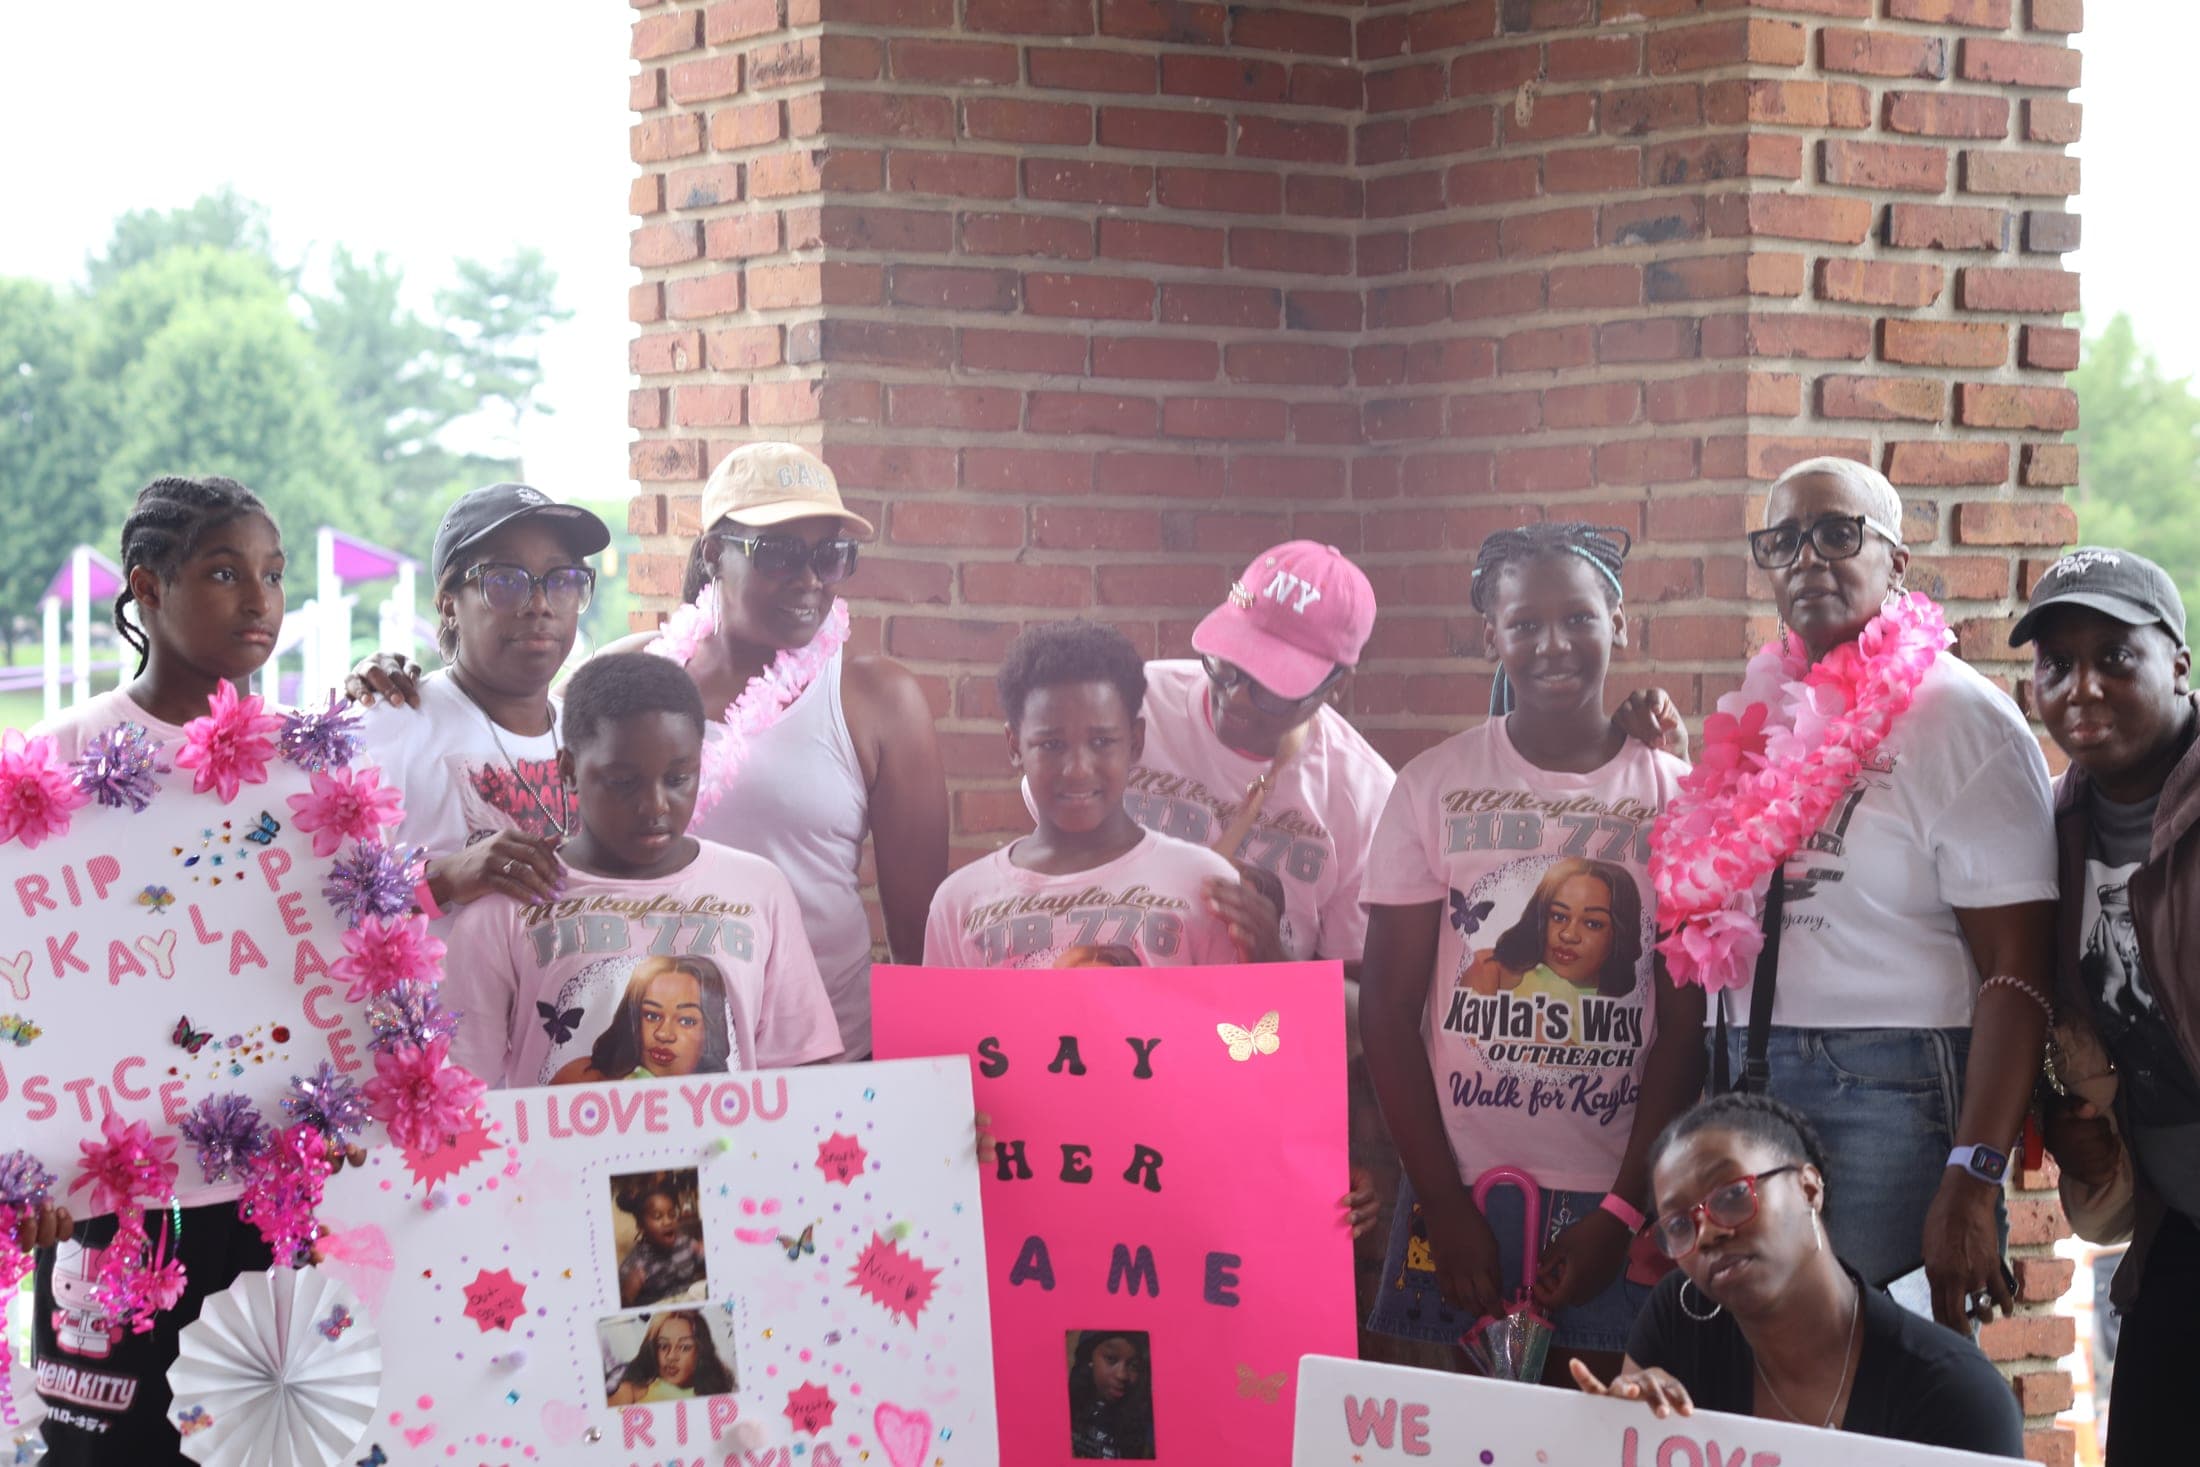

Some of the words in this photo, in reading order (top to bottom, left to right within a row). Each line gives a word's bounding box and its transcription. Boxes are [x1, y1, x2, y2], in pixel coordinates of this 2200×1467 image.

[1263, 569, 1321, 615] NY
[1443, 812, 1545, 856] HB
[14, 854, 121, 918] RIP
[0, 903, 268, 1000] YKAYLA
[528, 913, 632, 969] HB
[641, 913, 757, 963] 776
[1066, 907, 1184, 957] 776
[257, 847, 362, 1074] PEACE
[1443, 988, 1570, 1042] Kayla's
[1581, 997, 1645, 1048] Way
[977, 1035, 1162, 1080] SAY
[1487, 1043, 1637, 1068] OUTREACH
[0, 1054, 193, 1126] STICE
[515, 1099, 529, 1144] I
[547, 1087, 670, 1139] LOVE
[679, 1075, 789, 1128] YOU
[1449, 1070, 1523, 1108] Walk
[1527, 1079, 1570, 1117] for
[994, 1139, 1164, 1194] HER
[1008, 1235, 1243, 1308] AME
[36, 1359, 78, 1394] Hello
[76, 1371, 137, 1411] KITTY
[622, 1396, 740, 1450] RIP
[1344, 1394, 1431, 1456] WE
